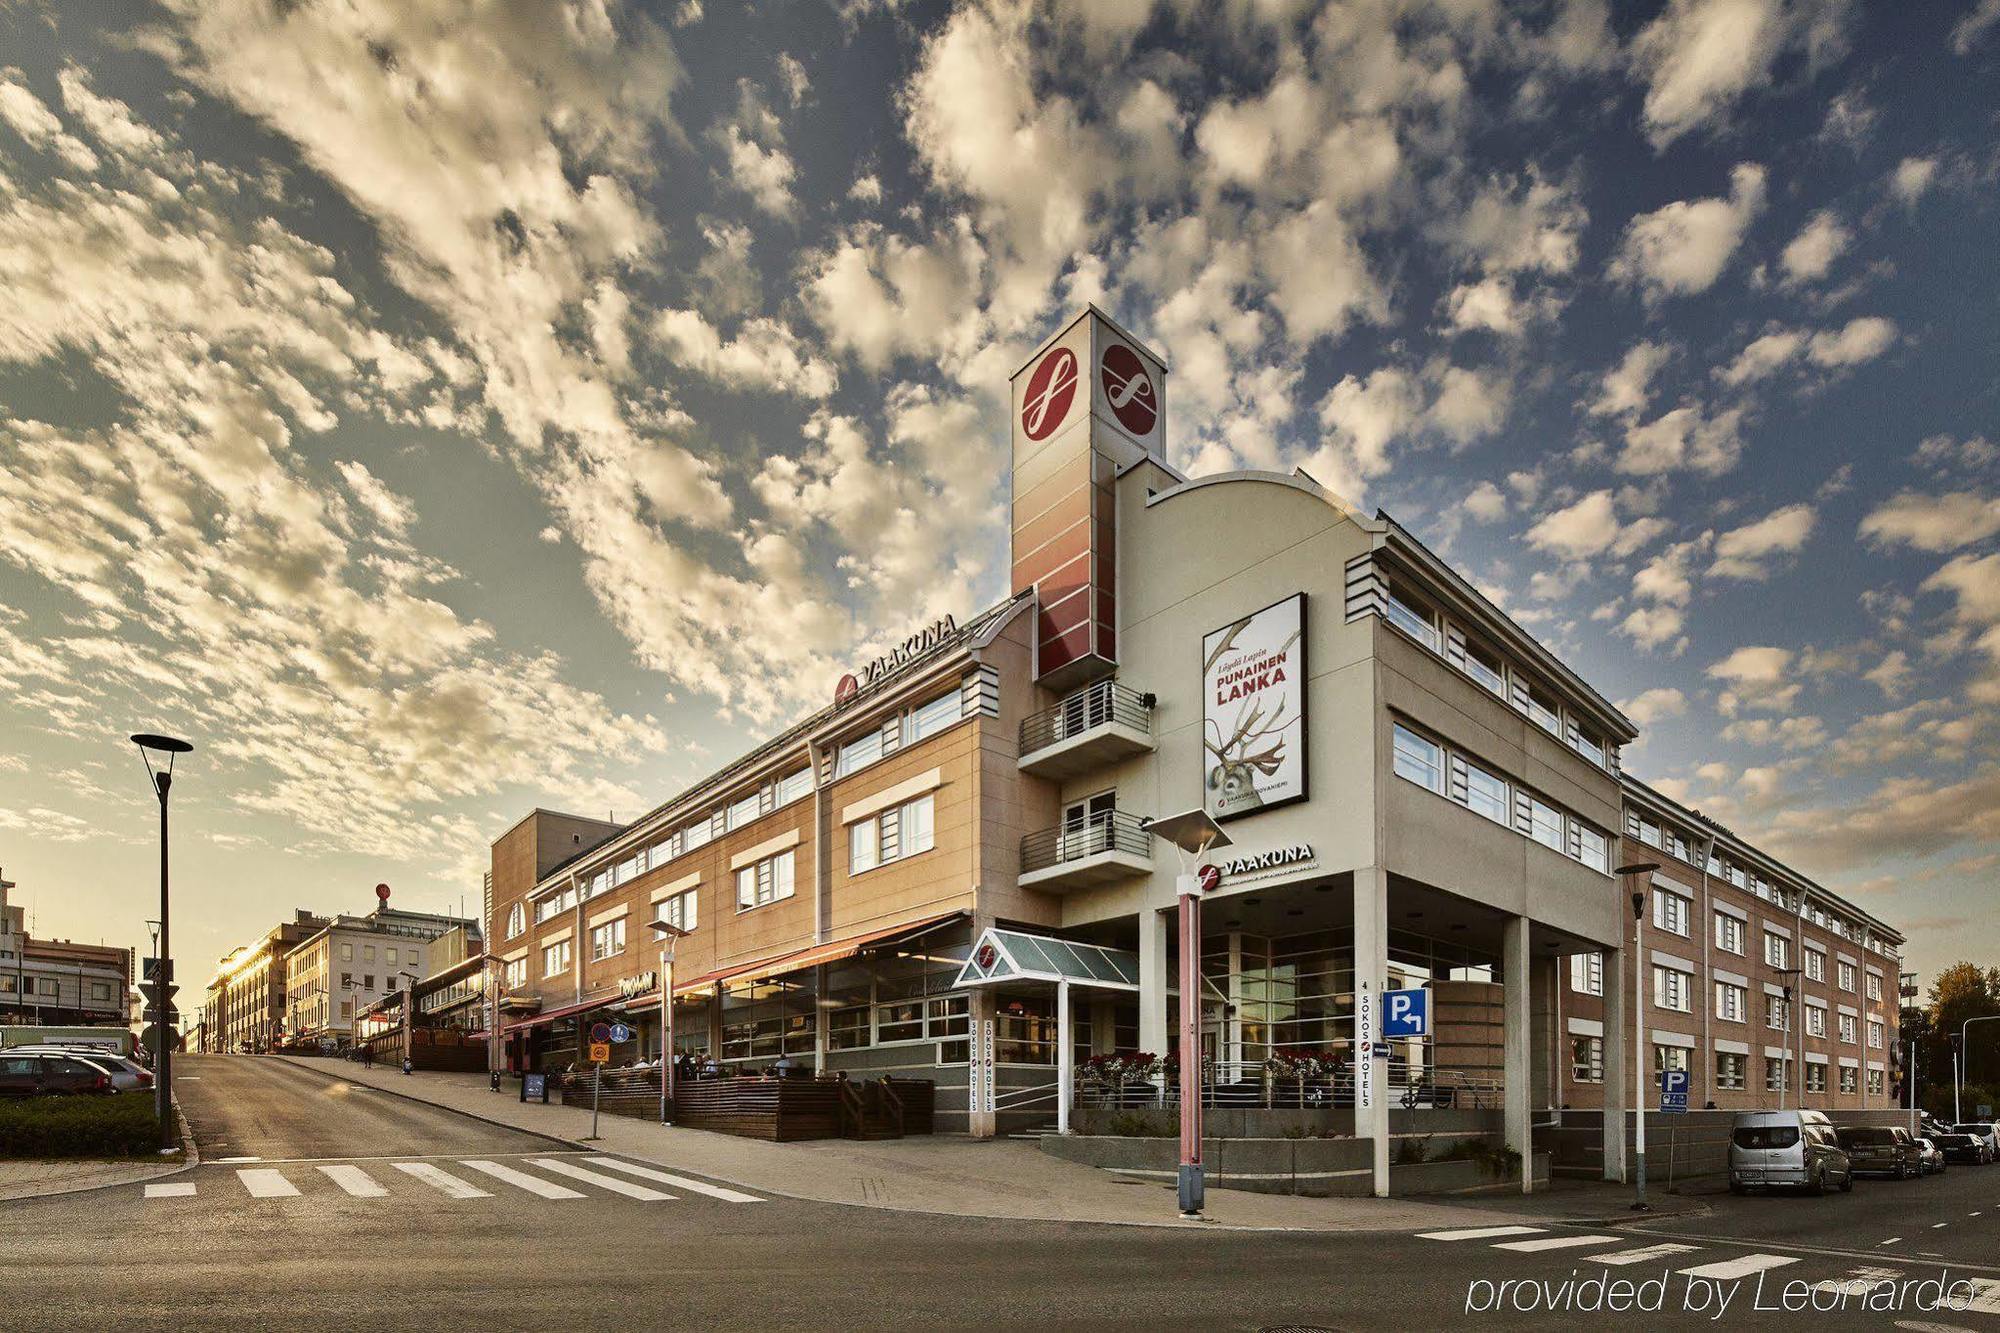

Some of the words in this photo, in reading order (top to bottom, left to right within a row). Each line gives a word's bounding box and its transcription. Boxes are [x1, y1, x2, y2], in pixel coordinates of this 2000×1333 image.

[862, 613, 957, 682] VAAKUNA
[1242, 648, 1267, 664] Lapin
[1217, 651, 1287, 688] PUNAINEN
[1217, 667, 1287, 706] LANKA
[1224, 843, 1315, 875] VAAKUNA
[1361, 981, 1368, 990] 4
[1362, 996, 1370, 1039] SOKOS
[1391, 995, 1411, 1022] P
[1362, 1055, 1370, 1107] HOTELS
[1667, 1072, 1686, 1092] P
